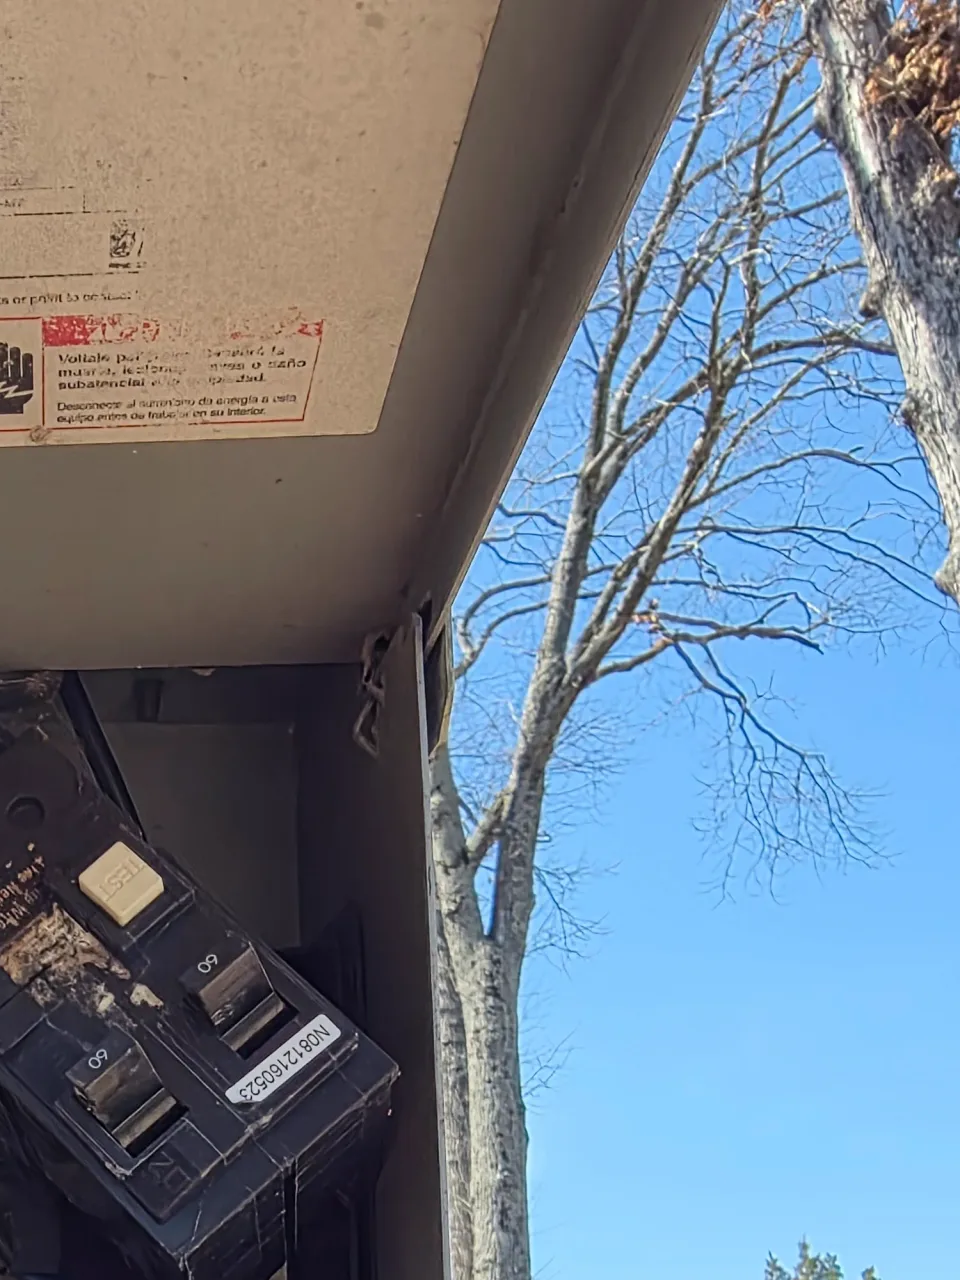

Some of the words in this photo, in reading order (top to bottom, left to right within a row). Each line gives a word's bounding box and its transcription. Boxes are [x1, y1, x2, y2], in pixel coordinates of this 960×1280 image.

[12, 296, 27, 304] or
[210, 409, 224, 417] su
[98, 855, 146, 903] TEST
[197, 954, 218, 974] 60
[88, 1048, 109, 1069] 60
[239, 1024, 331, 1102] N0812160523
